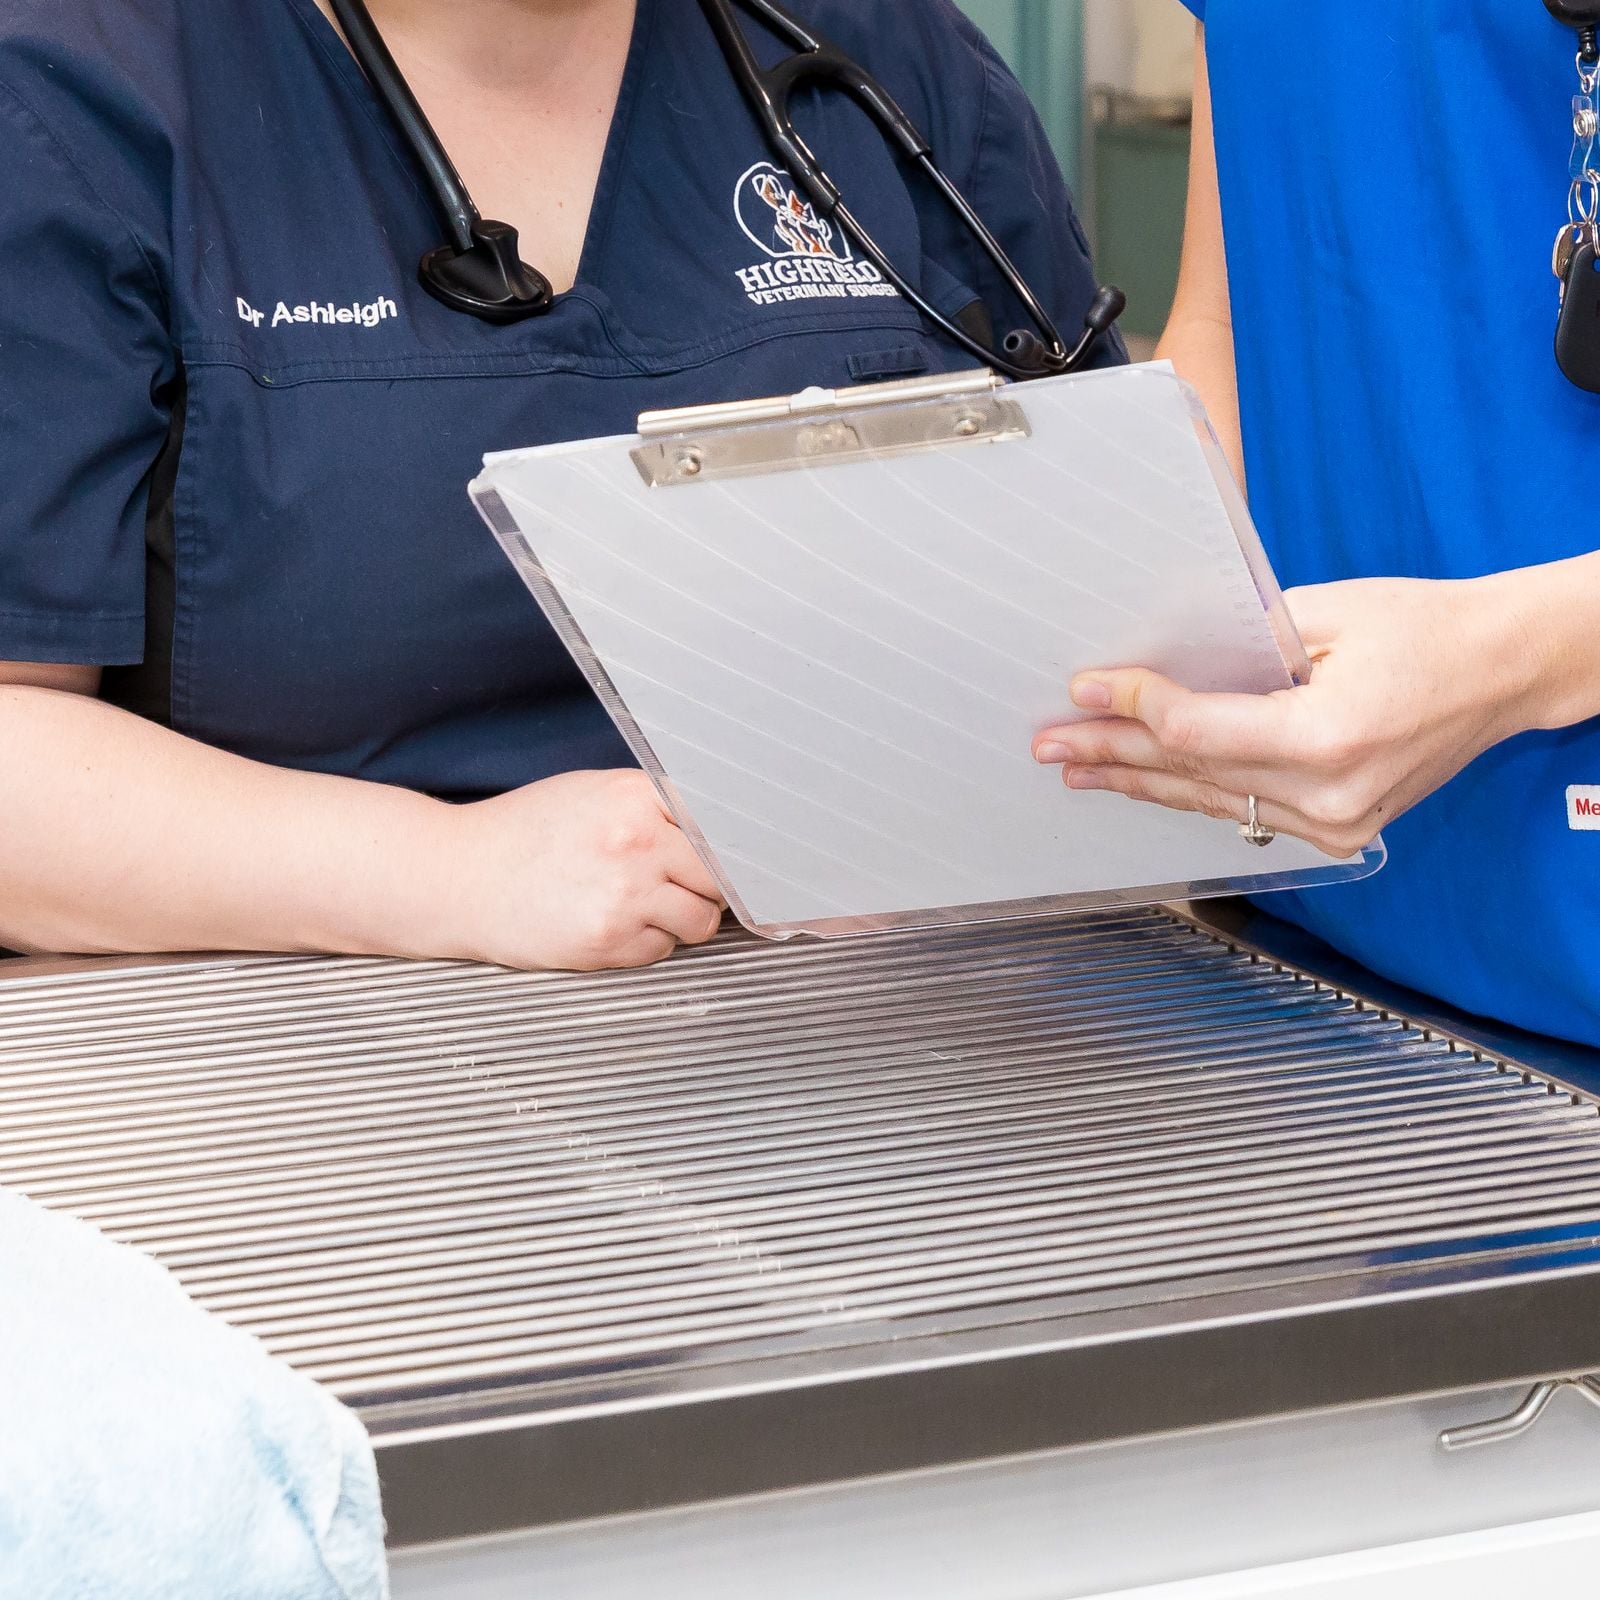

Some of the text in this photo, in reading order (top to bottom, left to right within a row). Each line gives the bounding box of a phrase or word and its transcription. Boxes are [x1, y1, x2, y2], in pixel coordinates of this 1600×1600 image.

[735, 258, 883, 292] HIGHFIELD
[747, 283, 901, 306] VETERINARY SURGER
[236, 296, 398, 328] Dr Ashleigh
